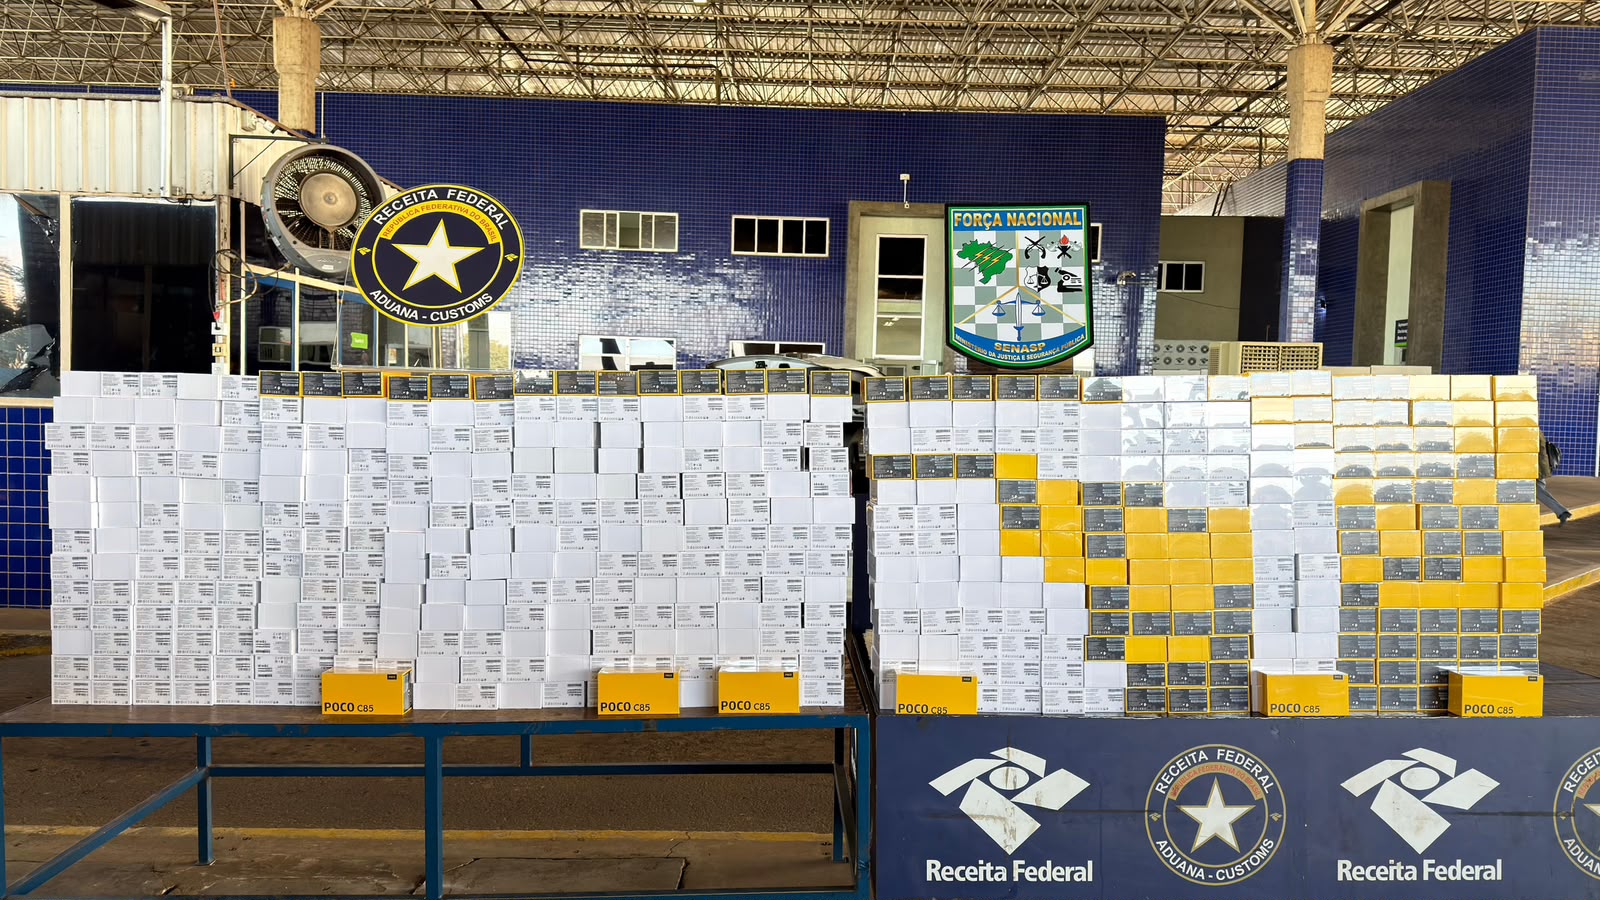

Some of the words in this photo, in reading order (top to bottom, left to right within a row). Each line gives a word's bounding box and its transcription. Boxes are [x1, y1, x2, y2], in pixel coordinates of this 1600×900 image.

[324, 702, 355, 712] POCO
[357, 704, 374, 712] C85
[600, 702, 631, 712] POCO
[633, 704, 650, 712] C85
[720, 700, 751, 711] POCO
[753, 702, 770, 711] C85
[898, 703, 929, 714] POCO
[931, 706, 948, 715] C85
[1270, 703, 1301, 713] POCO
[1303, 705, 1320, 713] C85
[1464, 704, 1495, 714] POCO
[1497, 706, 1514, 715] C85
[1155, 750, 1209, 794] RECEITA
[1216, 749, 1274, 794] FEDERAL
[1563, 751, 1600, 793] RECEI
[1156, 839, 1205, 880] ADUANA
[1215, 838, 1275, 881] CUSTOMS
[926, 859, 1008, 883] Receita
[1013, 859, 1093, 882] Federal
[1337, 859, 1418, 881] Receita
[1423, 858, 1503, 881] Federal
